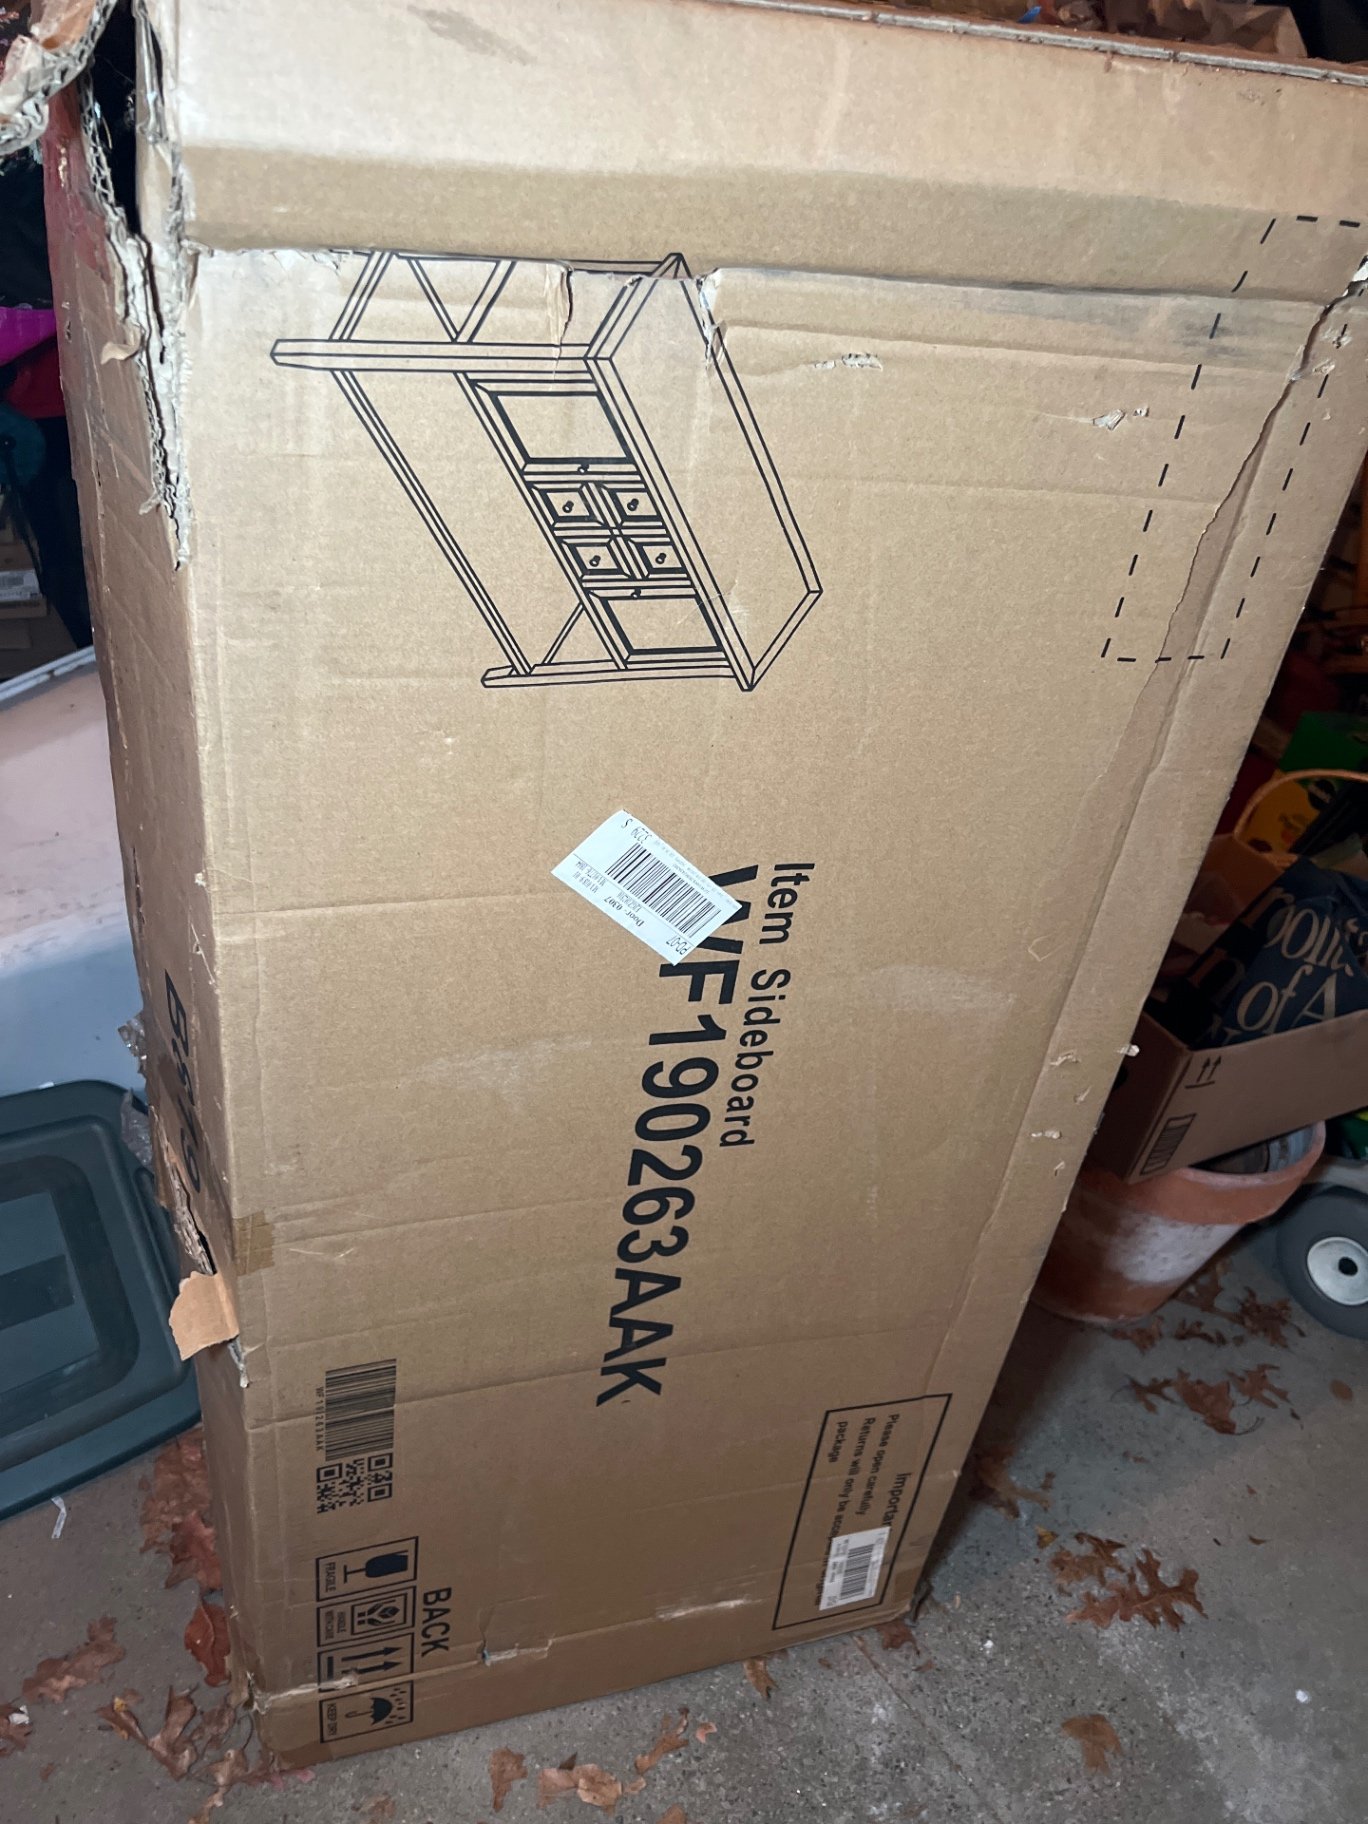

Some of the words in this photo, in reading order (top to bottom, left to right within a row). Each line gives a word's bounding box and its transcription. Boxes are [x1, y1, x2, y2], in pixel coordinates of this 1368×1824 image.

[759, 862, 816, 944] Item
[719, 967, 792, 1148] Sideboard
[828, 1420, 850, 1463] package
[853, 1417, 876, 1458] Returns
[879, 1413, 900, 1447] Please
[848, 1459, 864, 1476] will
[869, 1449, 886, 1474] open
[835, 1500, 850, 1512] be
[838, 1478, 855, 1499] only
[855, 1475, 878, 1515] carefully
[881, 1472, 912, 1530] Importa
[325, 1561, 336, 1593] FRAGILE
[421, 1587, 452, 1657] BACK
[327, 1702, 337, 1721] KEEP
